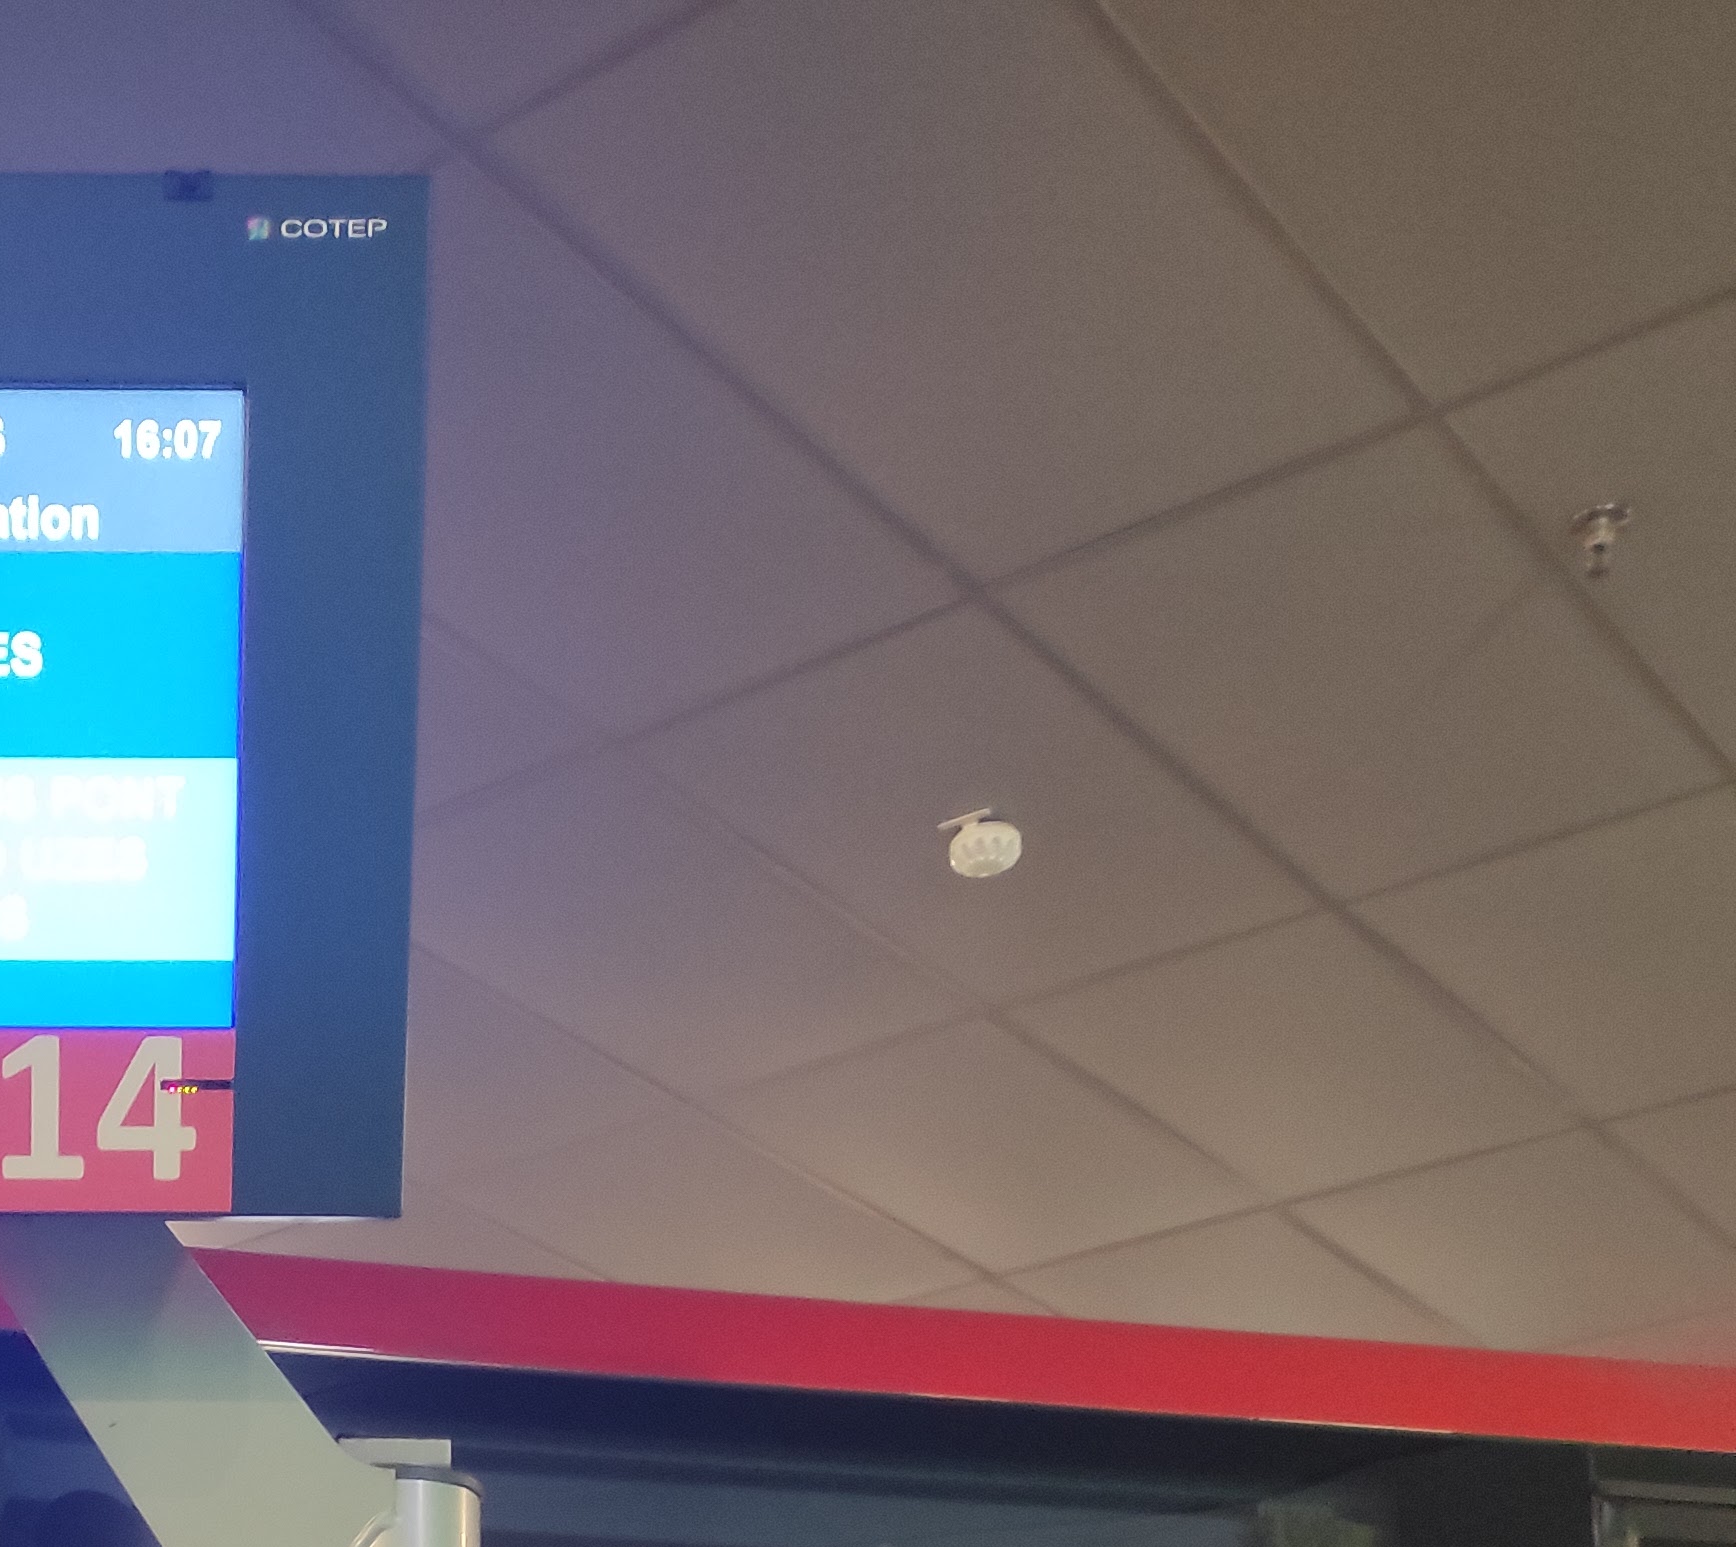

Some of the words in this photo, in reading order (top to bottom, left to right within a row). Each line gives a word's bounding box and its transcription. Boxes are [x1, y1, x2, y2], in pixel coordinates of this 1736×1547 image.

[280, 218, 388, 239] COTEP
[112, 418, 222, 460] 16:07
[0, 1034, 198, 1182] 14
